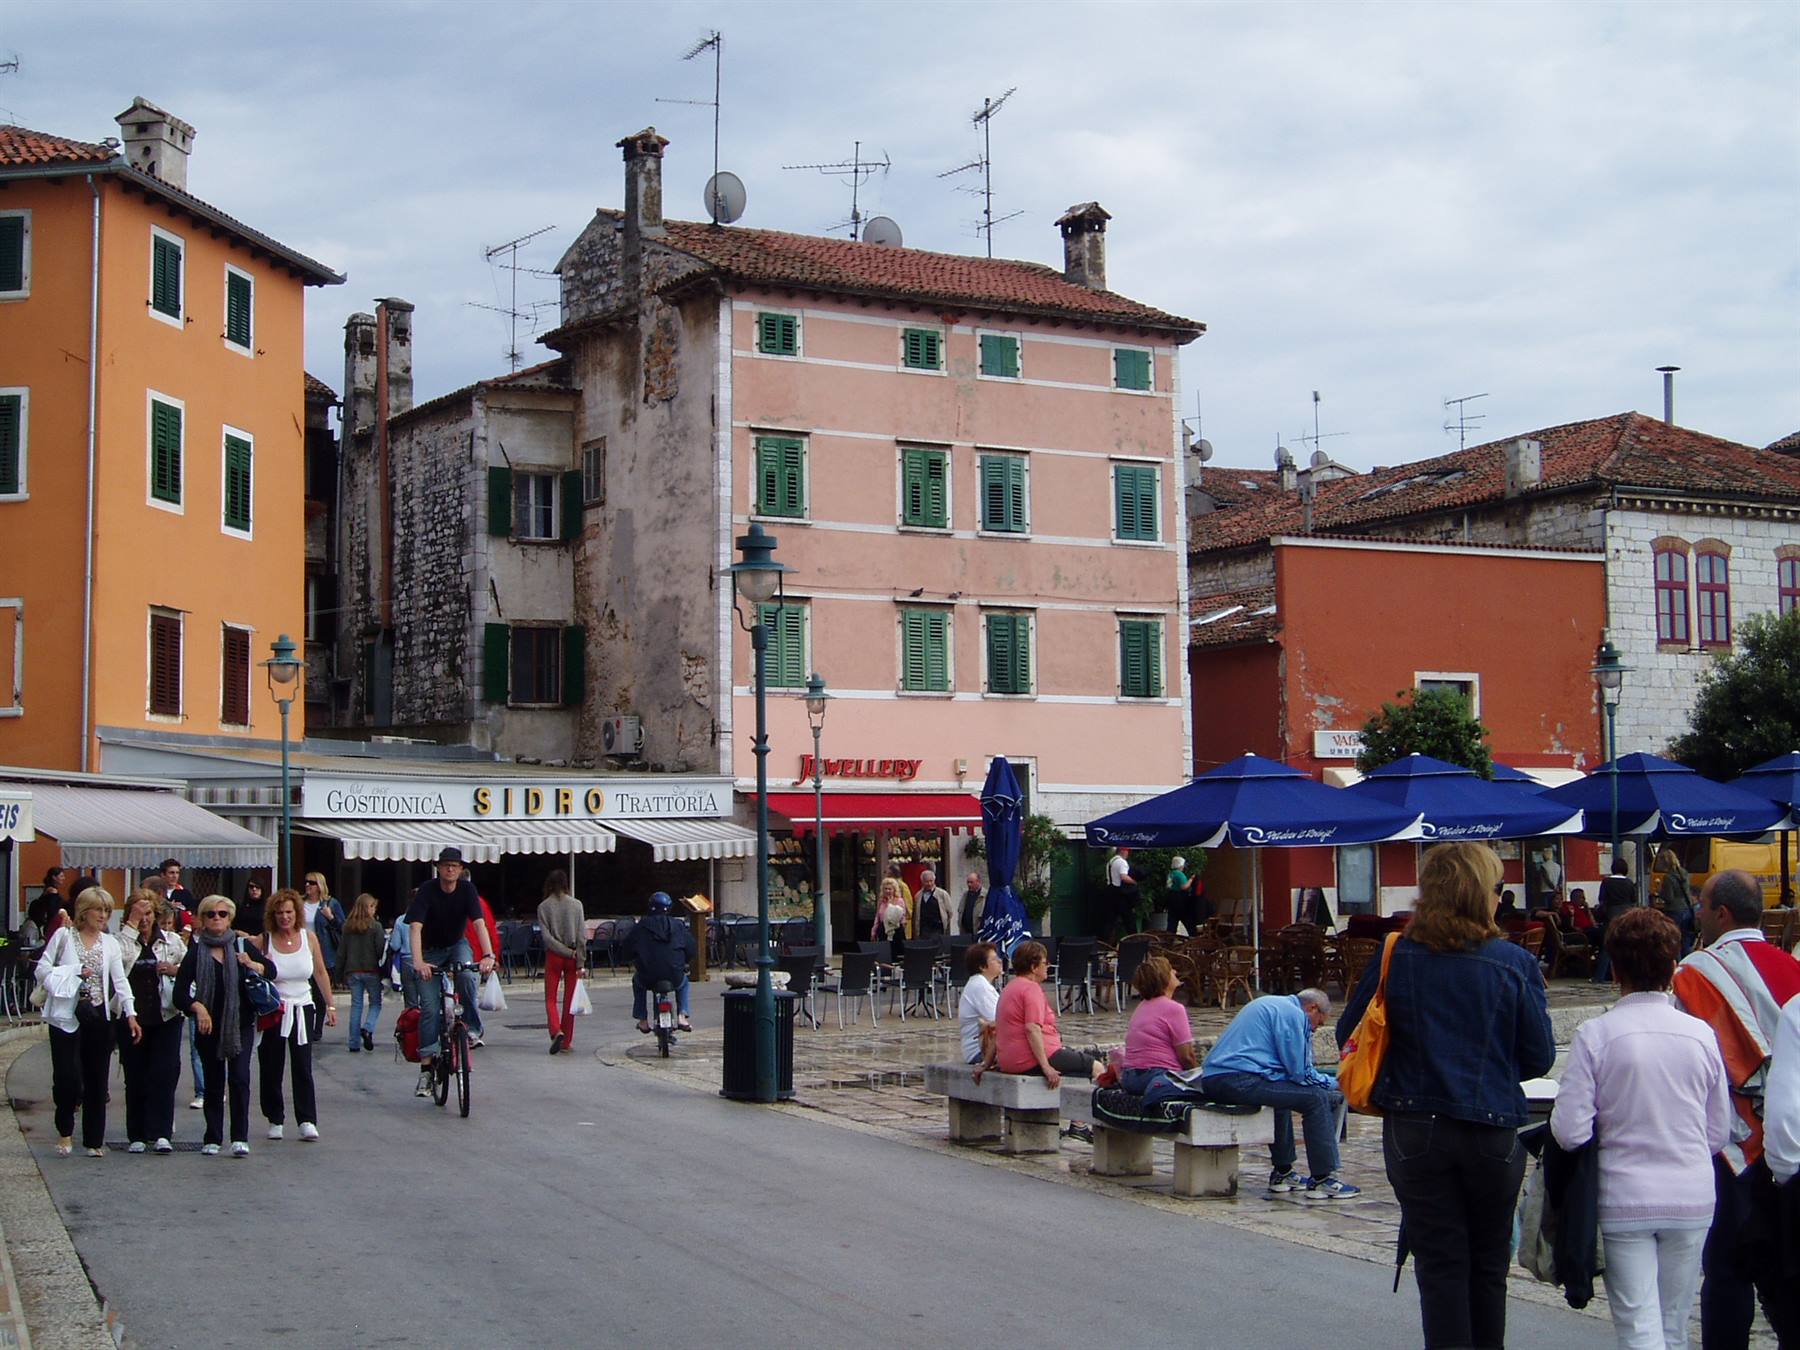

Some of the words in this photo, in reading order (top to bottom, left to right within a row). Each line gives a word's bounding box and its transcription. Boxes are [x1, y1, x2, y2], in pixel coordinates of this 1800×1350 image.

[792, 754, 922, 786] JEWELLERY
[327, 789, 447, 815] GOSTIONICA
[473, 787, 605, 815] SIDRO
[616, 793, 718, 813] TRATTORIA
